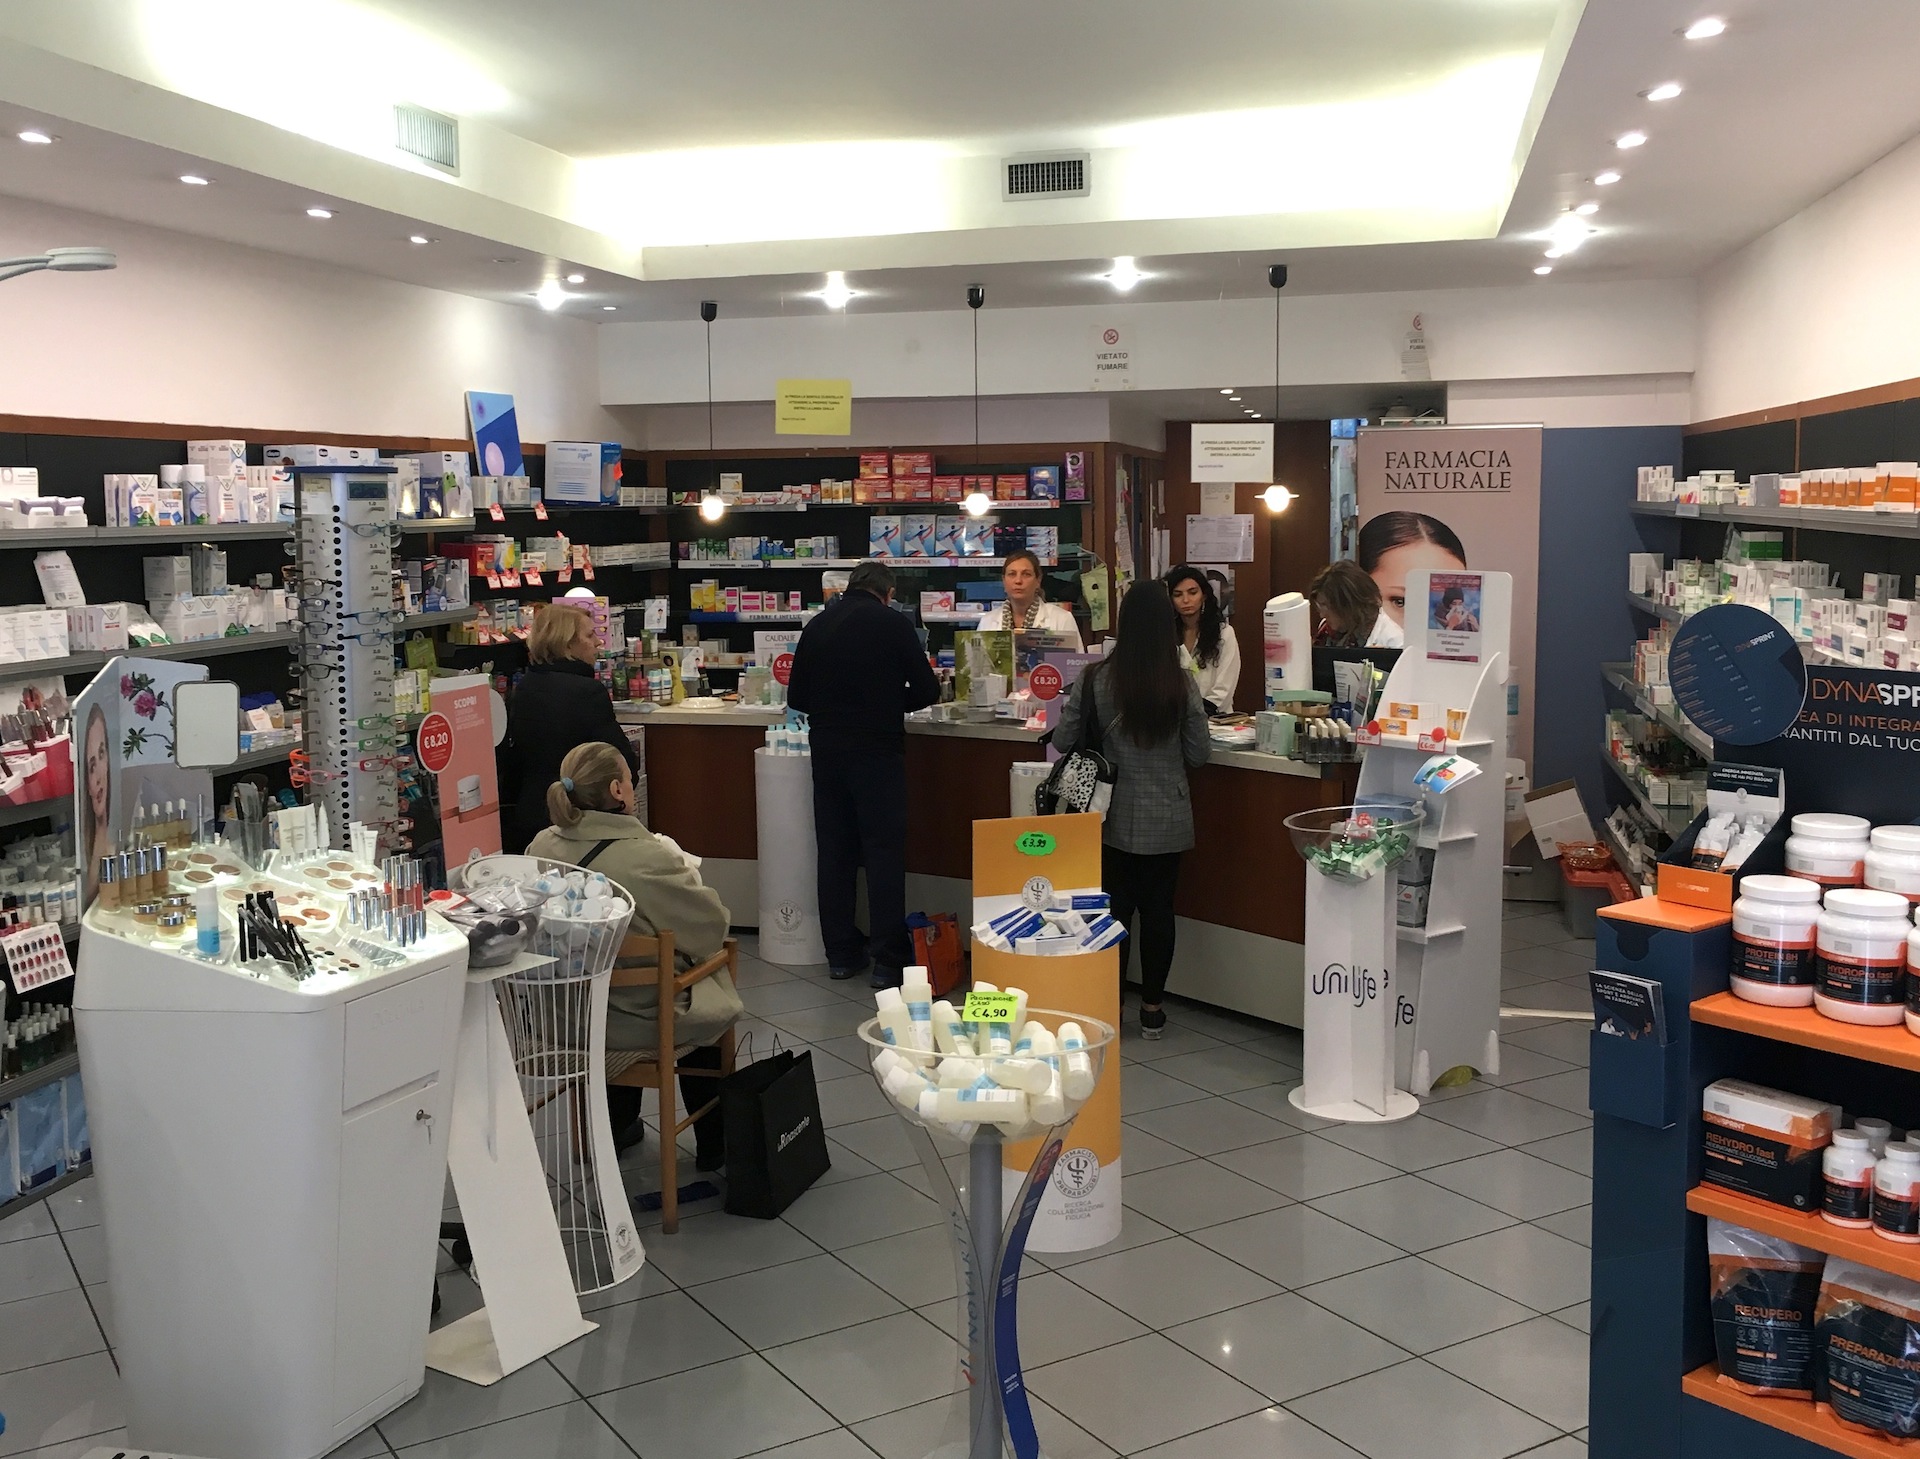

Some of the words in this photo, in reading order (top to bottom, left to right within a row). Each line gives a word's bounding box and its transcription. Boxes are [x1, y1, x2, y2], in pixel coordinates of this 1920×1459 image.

[1096, 352, 1128, 360] VIETATO
[1097, 363, 1128, 371] FUMARE
[1385, 450, 1512, 469] FARMACIA
[1385, 471, 1512, 490] NATURALE
[1827, 713, 1842, 726] DI
[1849, 715, 1920, 732] INTEGRA
[1849, 733, 1882, 748] DAL
[1745, 947, 1784, 960] PROTEIN
[1876, 971, 1894, 979] fast
[1611, 996, 1640, 1007] FARMACIA
[1706, 1132, 1754, 1154] REHYDRO
[1755, 1146, 1775, 1160] fast
[1058, 1149, 1097, 1167] FARMACISTI
[1056, 1175, 1098, 1197] PREPARATORI
[949, 1208, 978, 1343] NOVARTIS
[1734, 1304, 1802, 1321] RECUPERO
